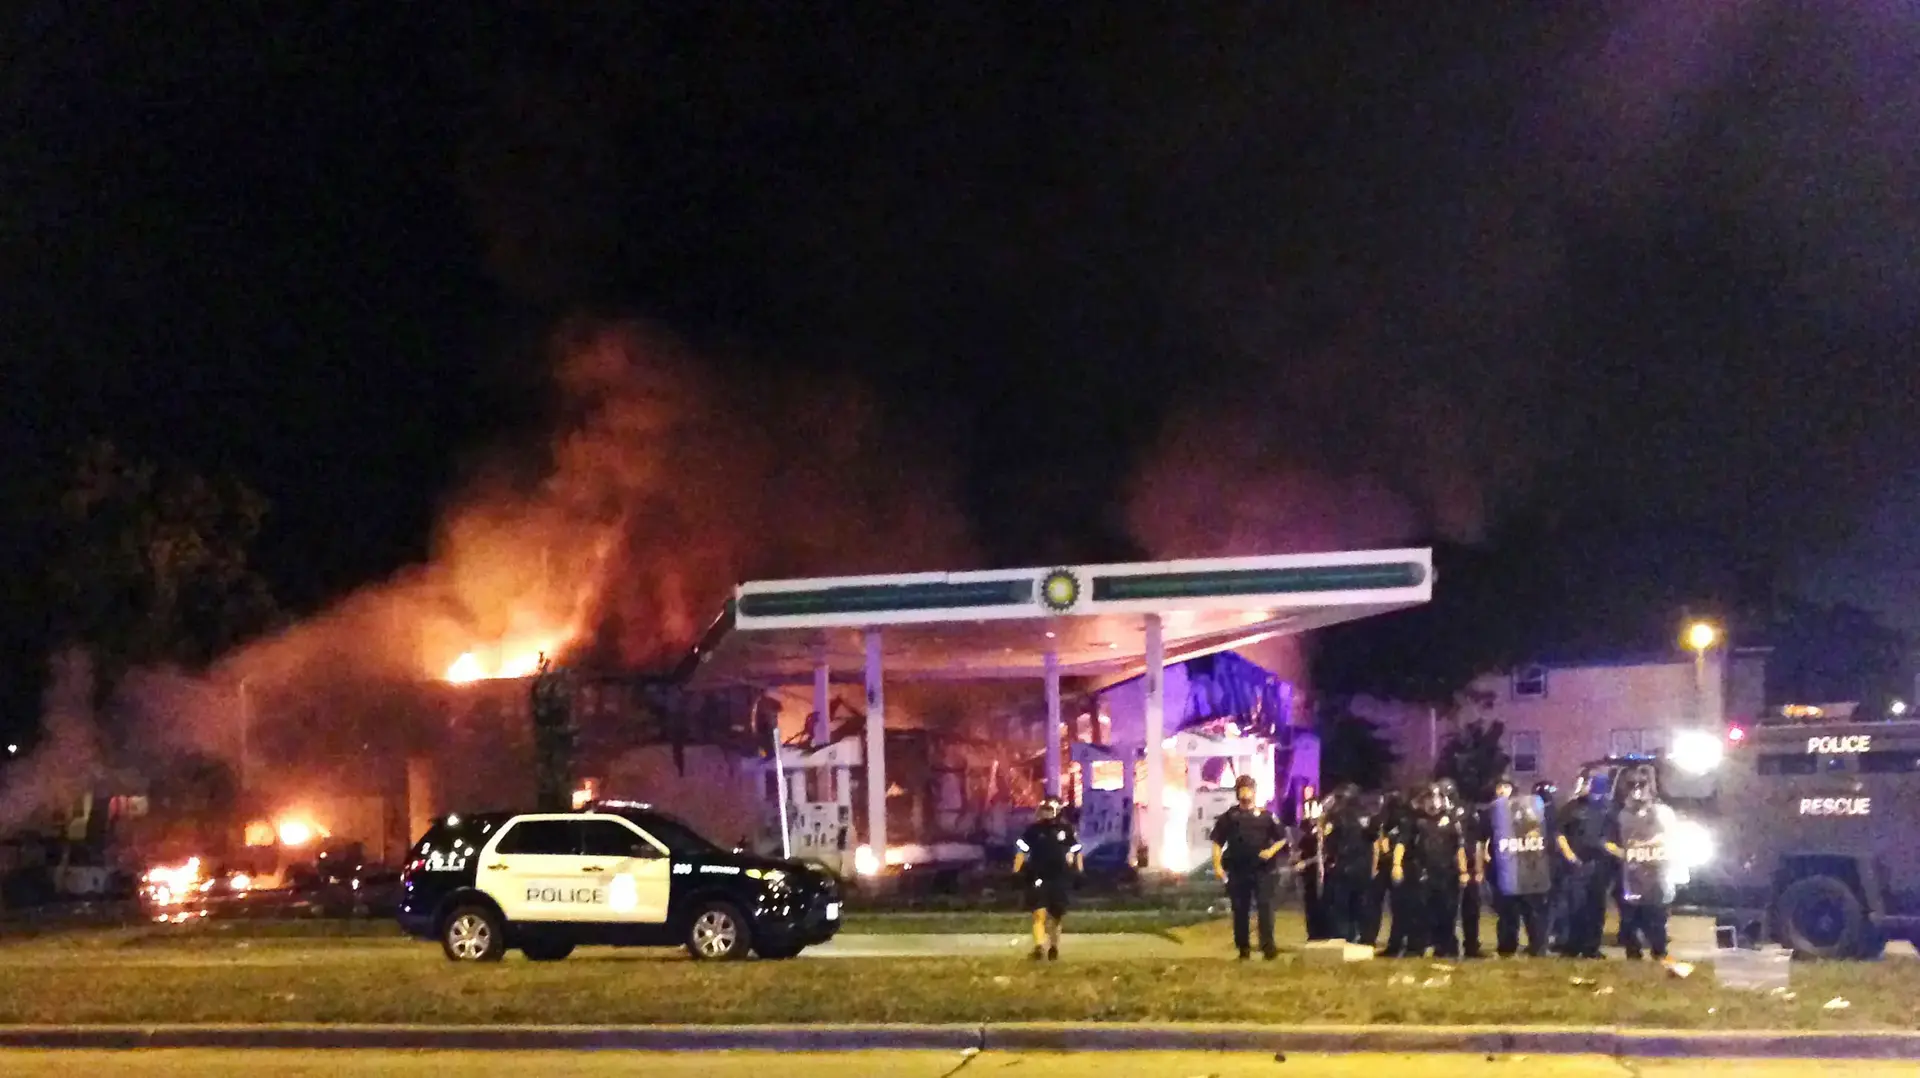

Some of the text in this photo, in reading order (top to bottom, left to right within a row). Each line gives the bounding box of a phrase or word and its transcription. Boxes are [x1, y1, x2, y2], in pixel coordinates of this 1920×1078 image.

[1807, 735, 1871, 753] POLICE
[1800, 798, 1871, 815] RESCUE
[1499, 837, 1545, 853] POLICE
[1627, 847, 1674, 862] POLIC
[526, 887, 604, 904] POLICE
